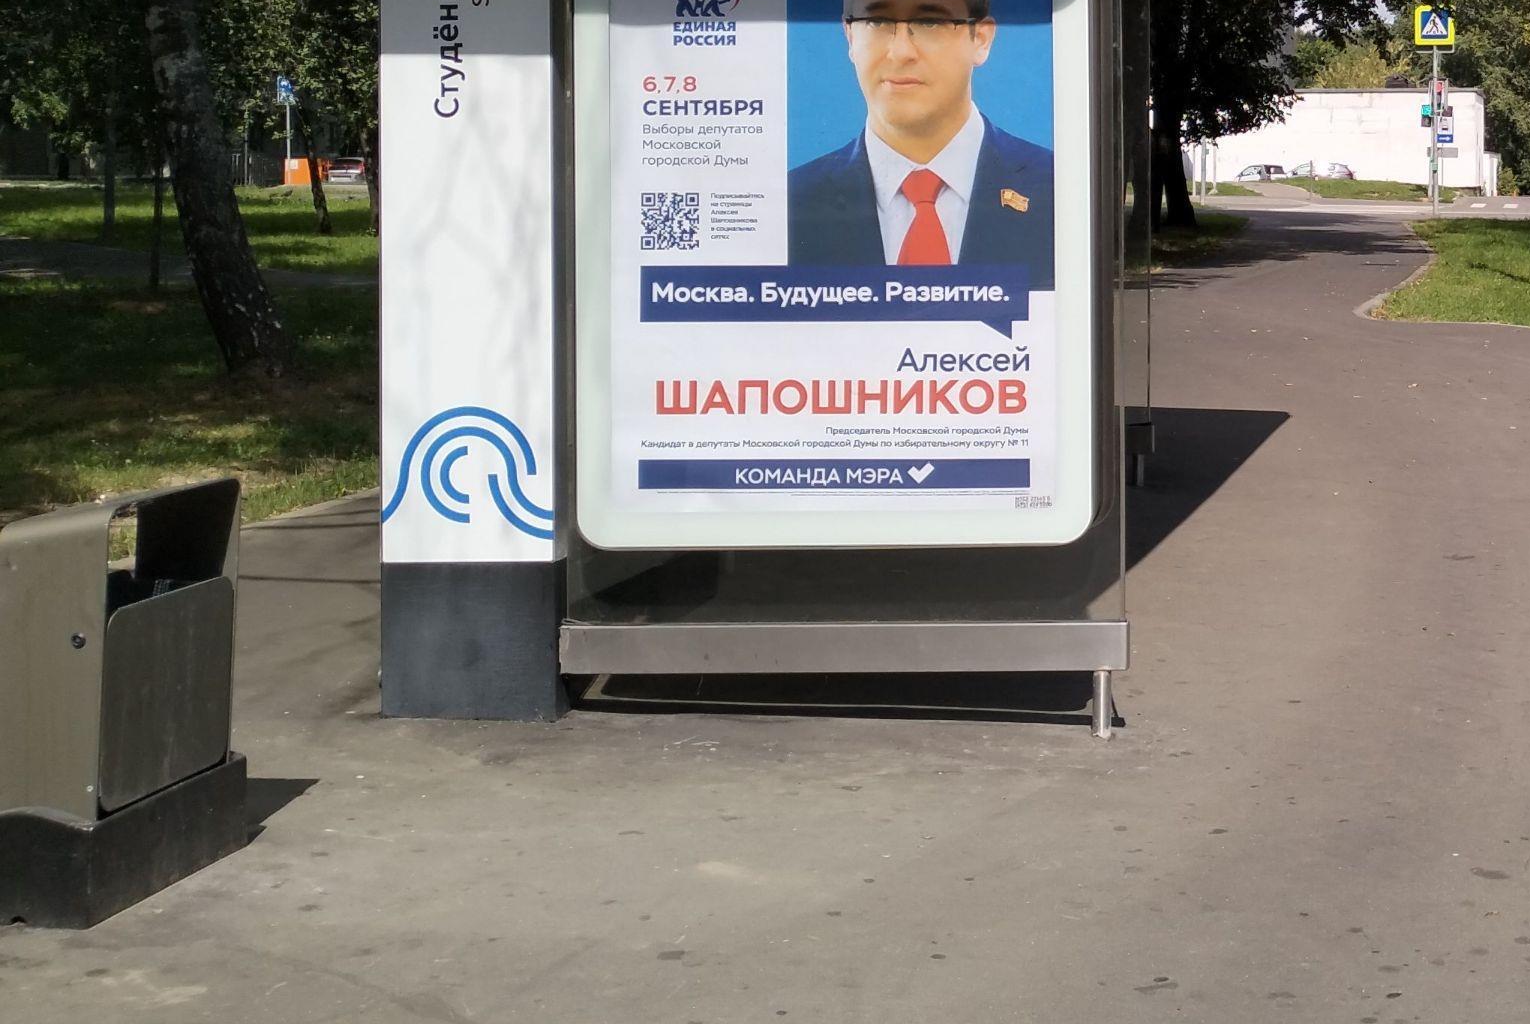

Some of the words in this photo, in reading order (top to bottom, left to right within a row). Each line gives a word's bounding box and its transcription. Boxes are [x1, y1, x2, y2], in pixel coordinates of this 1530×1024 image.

[672, 21, 737, 33] ЕДИНАЯ
[672, 35, 737, 46] РОССИЯ
[642, 99, 764, 116] СЕНТЯБРЯ
[642, 124, 694, 137] Выборы
[697, 125, 764, 137] депутатов
[642, 139, 721, 150] Московской
[642, 154, 710, 167] городской
[713, 154, 749, 167] Думы
[652, 282, 755, 303] Москва.
[760, 282, 880, 309] Будущее.
[885, 282, 1011, 303] Развитие.
[897, 345, 1031, 373] Алексей
[655, 379, 1028, 416] ШАПОШНИКОВ
[825, 427, 891, 437] Председатель
[892, 426, 950, 436] Московской
[951, 426, 1001, 437] городской
[1002, 427, 1029, 436] Думы
[640, 440, 686, 449] Кандидат
[695, 441, 741, 450] депутаты
[742, 439, 801, 449] Московской
[801, 439, 852, 449] городской
[852, 439, 879, 449] Думы
[880, 440, 893, 448] по
[894, 439, 971, 449] избирательному
[973, 440, 1006, 450] округу
[1007, 439, 1019, 447] №
[1020, 439, 1030, 447] 11
[735, 467, 841, 487] КОМАНДА
[846, 467, 904, 484] МЭРА
